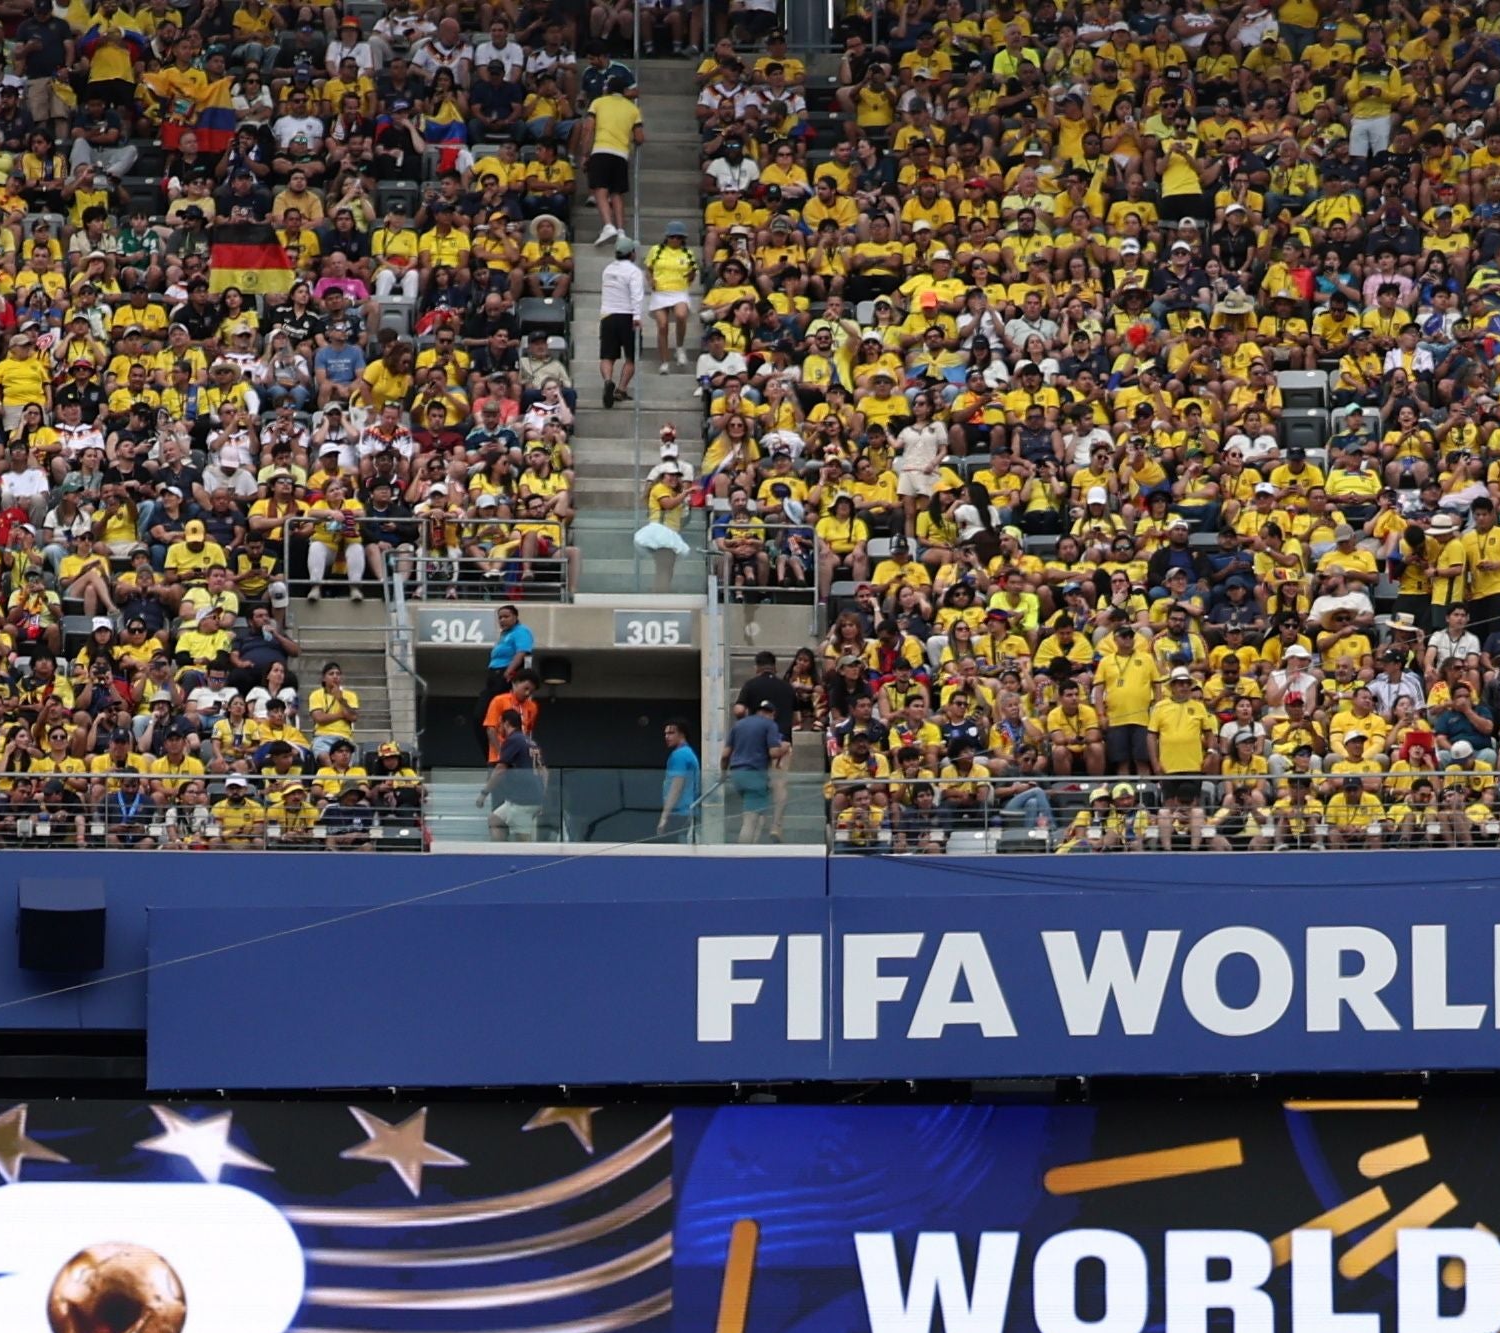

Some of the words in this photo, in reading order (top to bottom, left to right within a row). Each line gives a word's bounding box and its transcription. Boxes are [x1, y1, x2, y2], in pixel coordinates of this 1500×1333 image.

[430, 618, 485, 646] 304
[627, 620, 682, 647] 305
[696, 931, 1019, 1043] FIFA
